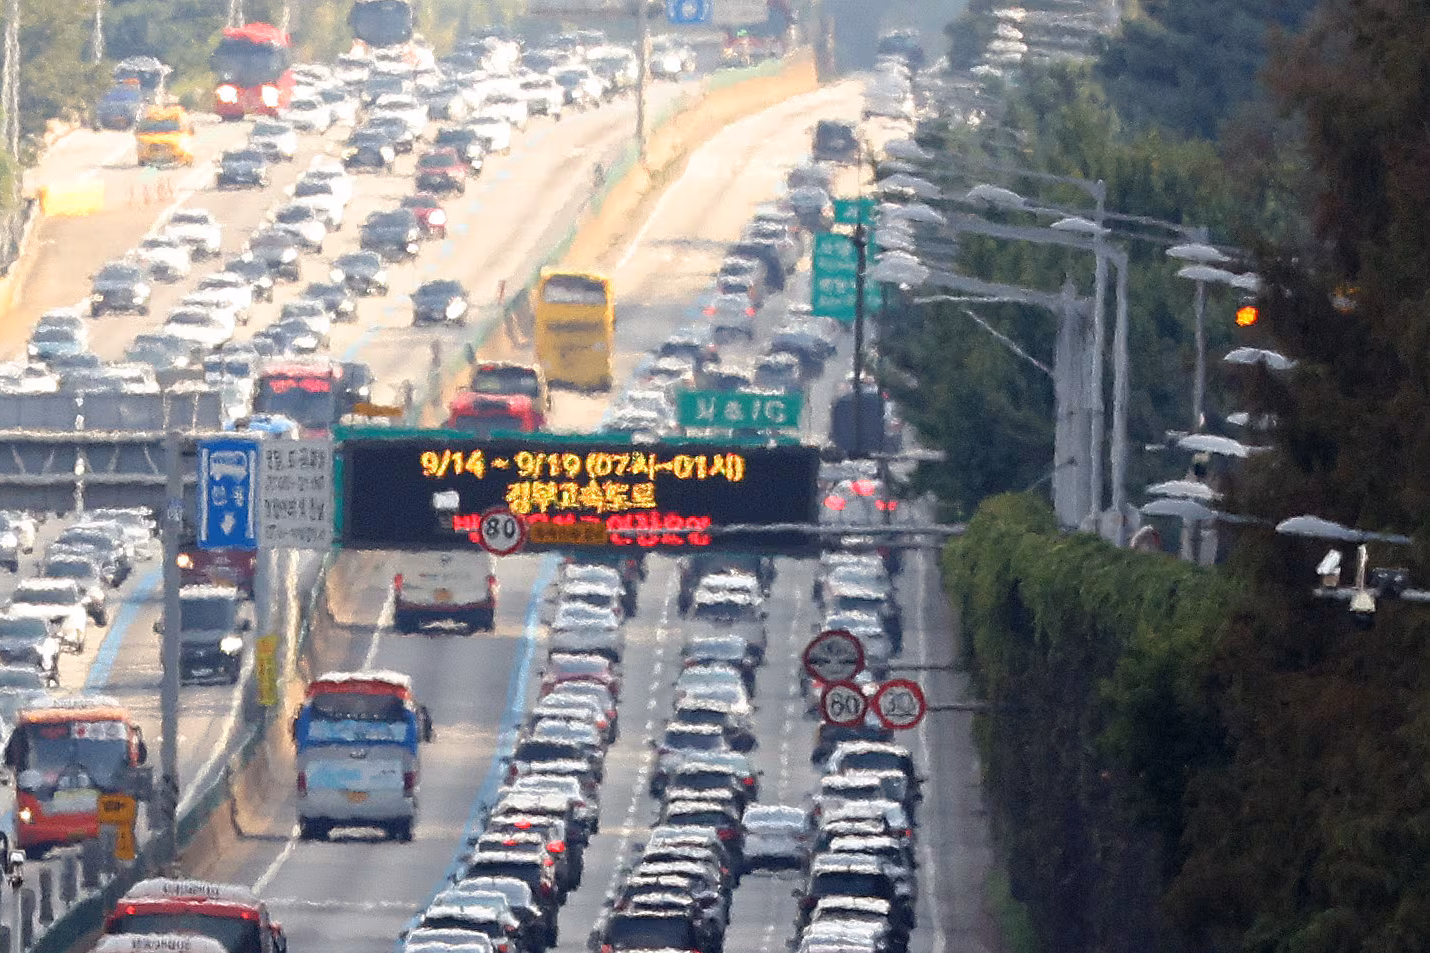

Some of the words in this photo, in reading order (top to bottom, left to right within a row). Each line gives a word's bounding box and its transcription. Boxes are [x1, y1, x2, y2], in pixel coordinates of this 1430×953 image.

[420, 449, 485, 479] 9/14
[485, 517, 516, 539] 80
[831, 692, 860, 717] 60
